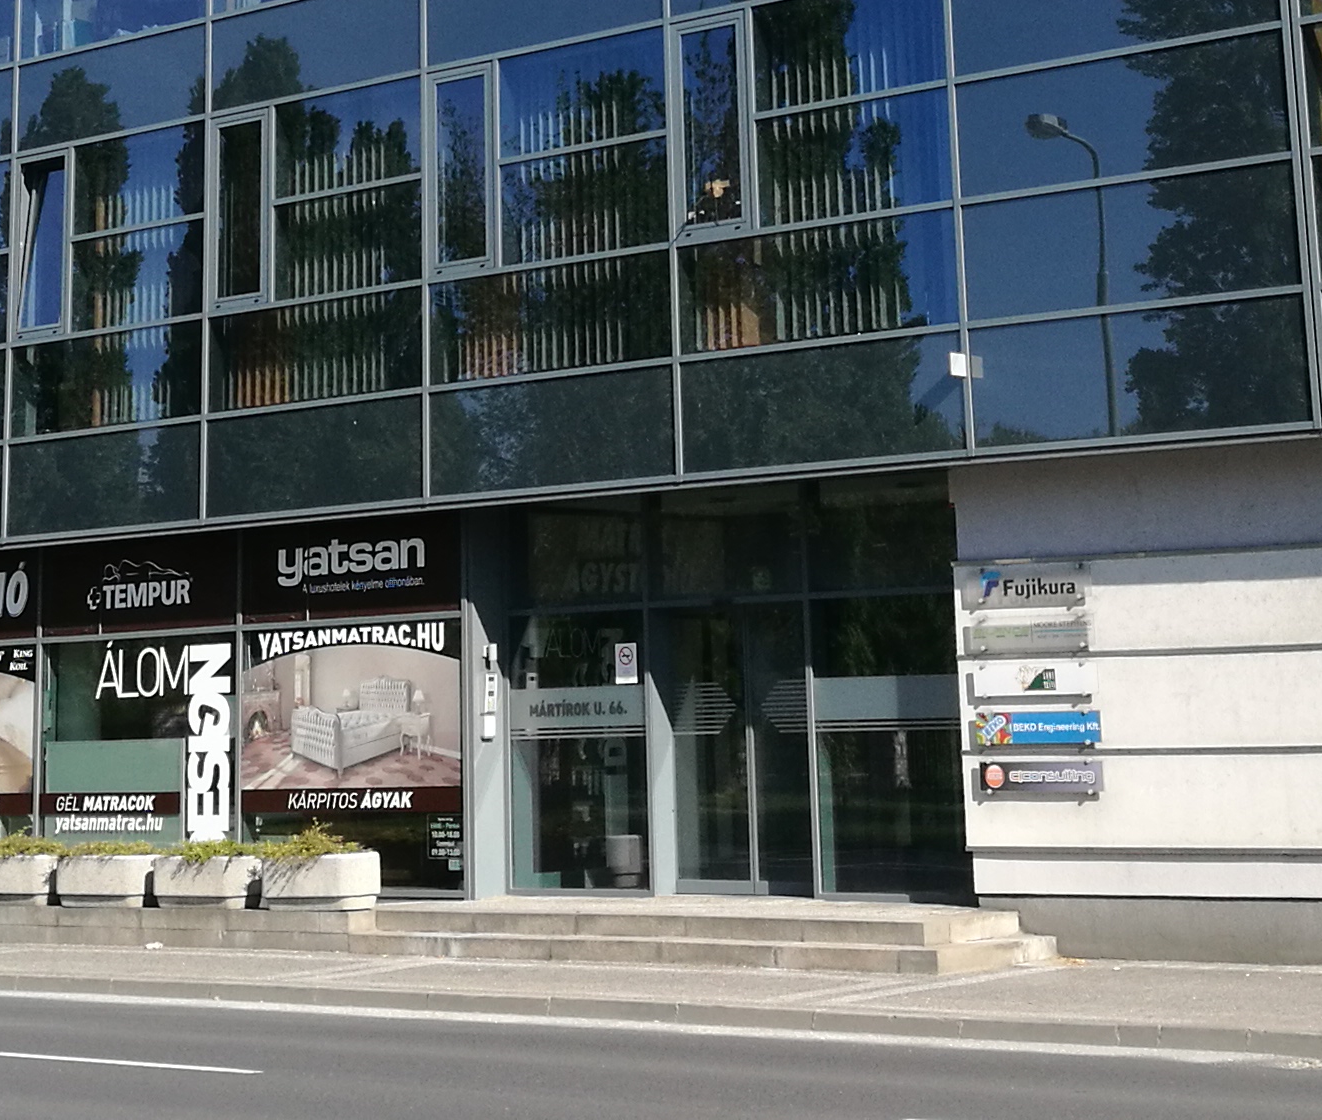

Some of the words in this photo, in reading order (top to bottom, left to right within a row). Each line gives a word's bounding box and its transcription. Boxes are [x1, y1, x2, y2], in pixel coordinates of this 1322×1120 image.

[277, 537, 425, 587] yatsan
[102, 579, 191, 610] TEMPUR
[302, 583, 308, 594] A
[1003, 577, 1076, 599] Fujikura
[258, 622, 446, 662] YATSANMATRAC.HU
[95, 640, 190, 700] ÁLOM
[529, 698, 590, 718] MÁRTÍROK
[594, 702, 606, 716] U.
[609, 700, 627, 715] 66.
[1013, 723, 1036, 732] BEKO
[1039, 723, 1085, 734] Engineering
[1087, 722, 1101, 731] Kft.
[187, 643, 232, 842] ESIGN
[56, 793, 80, 811] GÉL
[82, 794, 156, 811] MATRACOK
[288, 789, 359, 809] KÁRPITOS
[360, 788, 413, 809] ÁGYAK
[55, 813, 163, 834] yatsanmatrac.hu
